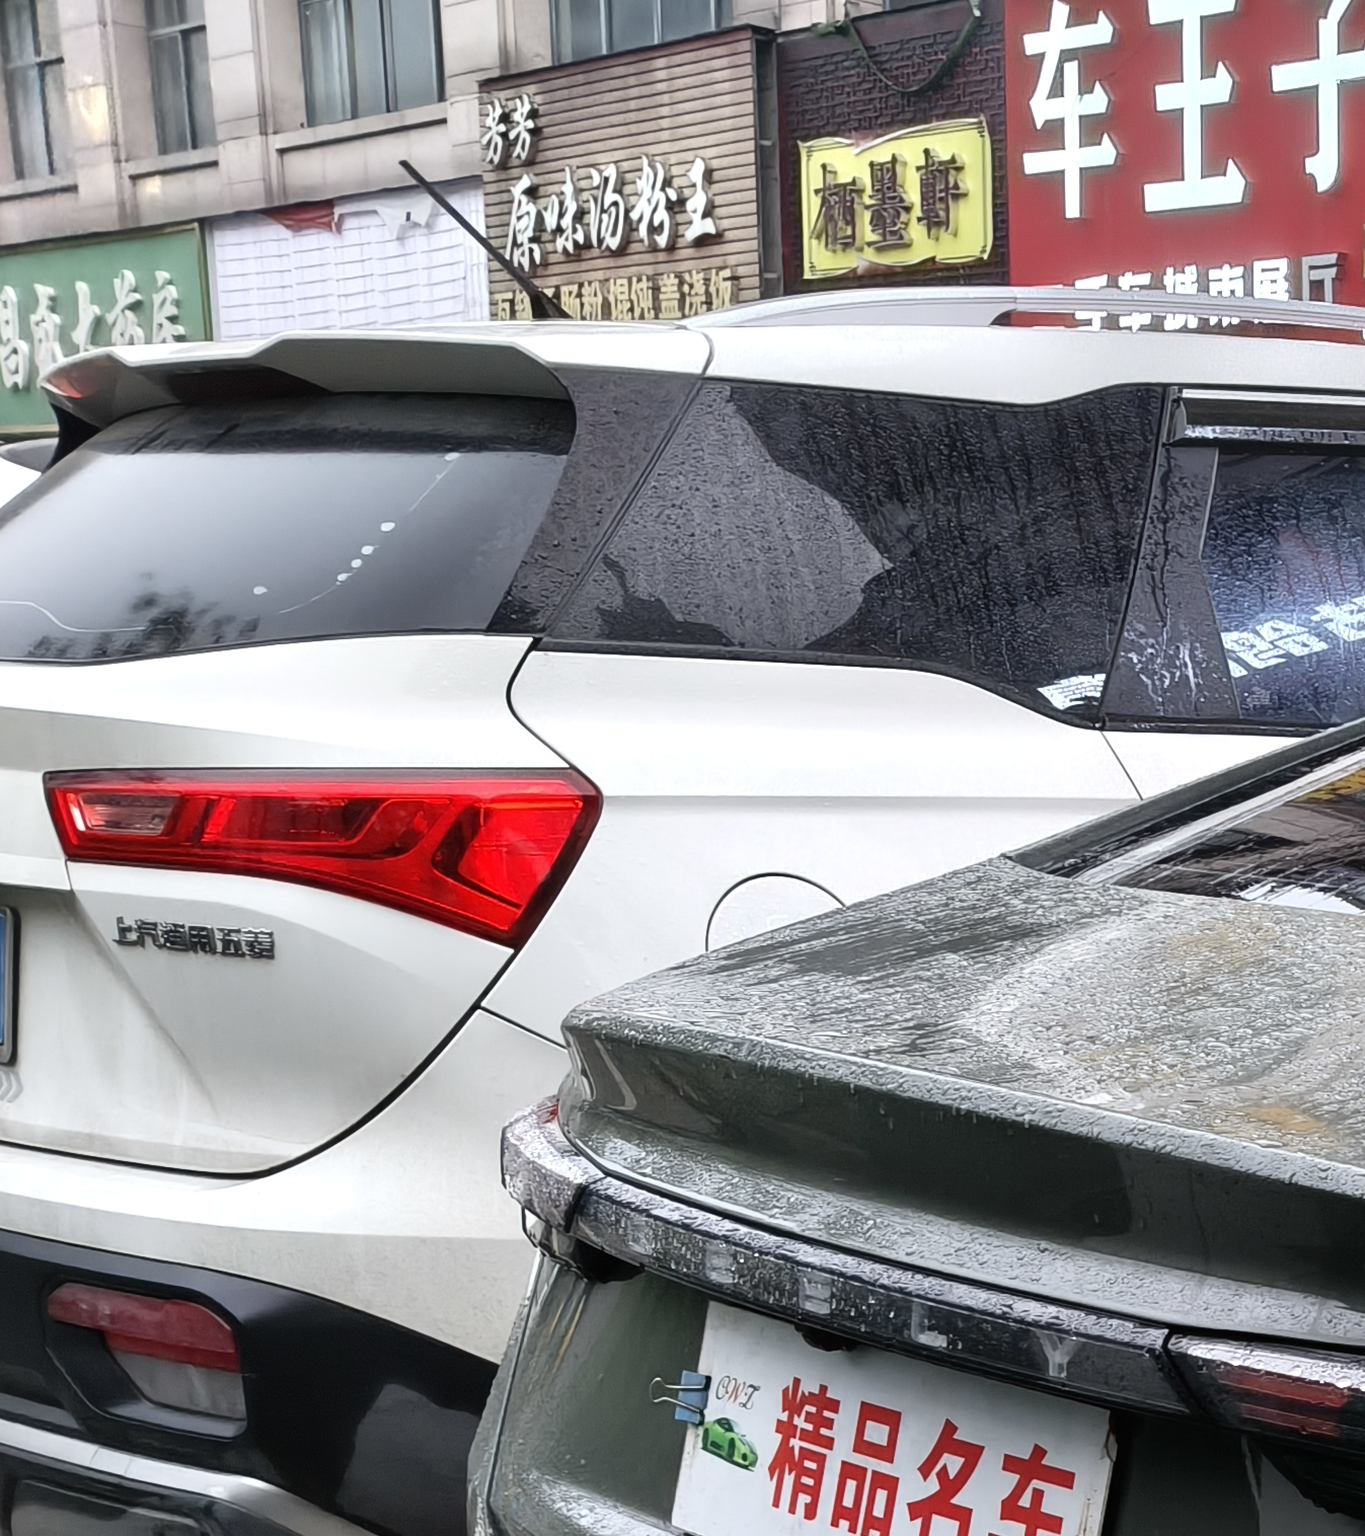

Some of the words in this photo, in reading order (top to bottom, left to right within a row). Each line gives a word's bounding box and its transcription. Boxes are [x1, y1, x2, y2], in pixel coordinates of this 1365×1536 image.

[505, 155, 717, 273] 原味汤粉王
[112, 916, 275, 960] 上汽通用五菱
